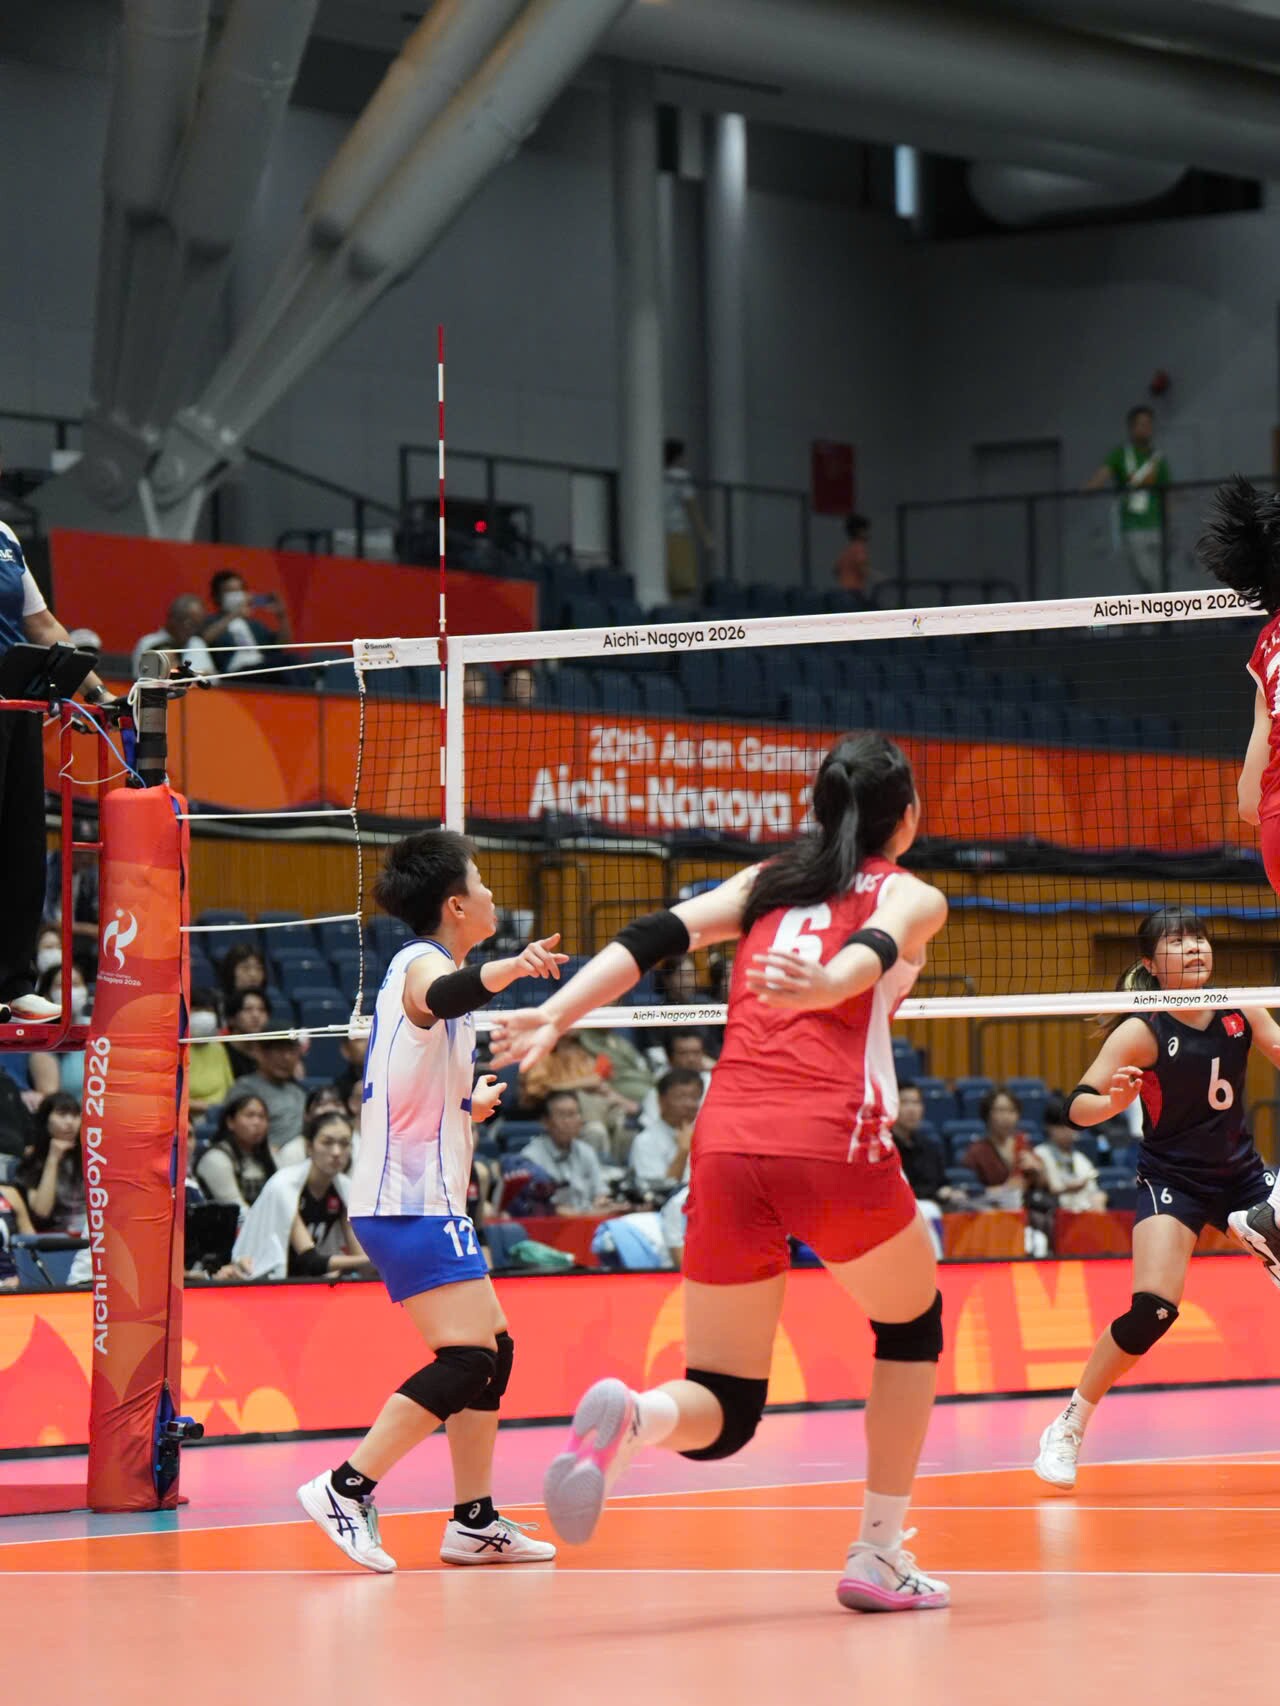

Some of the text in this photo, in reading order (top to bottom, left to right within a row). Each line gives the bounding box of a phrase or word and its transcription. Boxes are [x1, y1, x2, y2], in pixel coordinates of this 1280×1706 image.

[1093, 593, 1247, 617] Aichi-Nagoya 2026
[603, 626, 746, 648] Aichi-Nagoya 2026
[590, 725, 655, 764] 20th
[528, 763, 793, 842] Aichi-Nagoya
[632, 1008, 722, 1021] Aichi-Nagoya 2026
[1133, 993, 1229, 1006] Aichi-Nagoya 2026
[1207, 1057, 1235, 1111] 6
[86, 1036, 111, 1356] Aichi-Nagoya 2026
[1160, 1187, 1173, 1204] 6
[443, 1219, 478, 1257] 12
